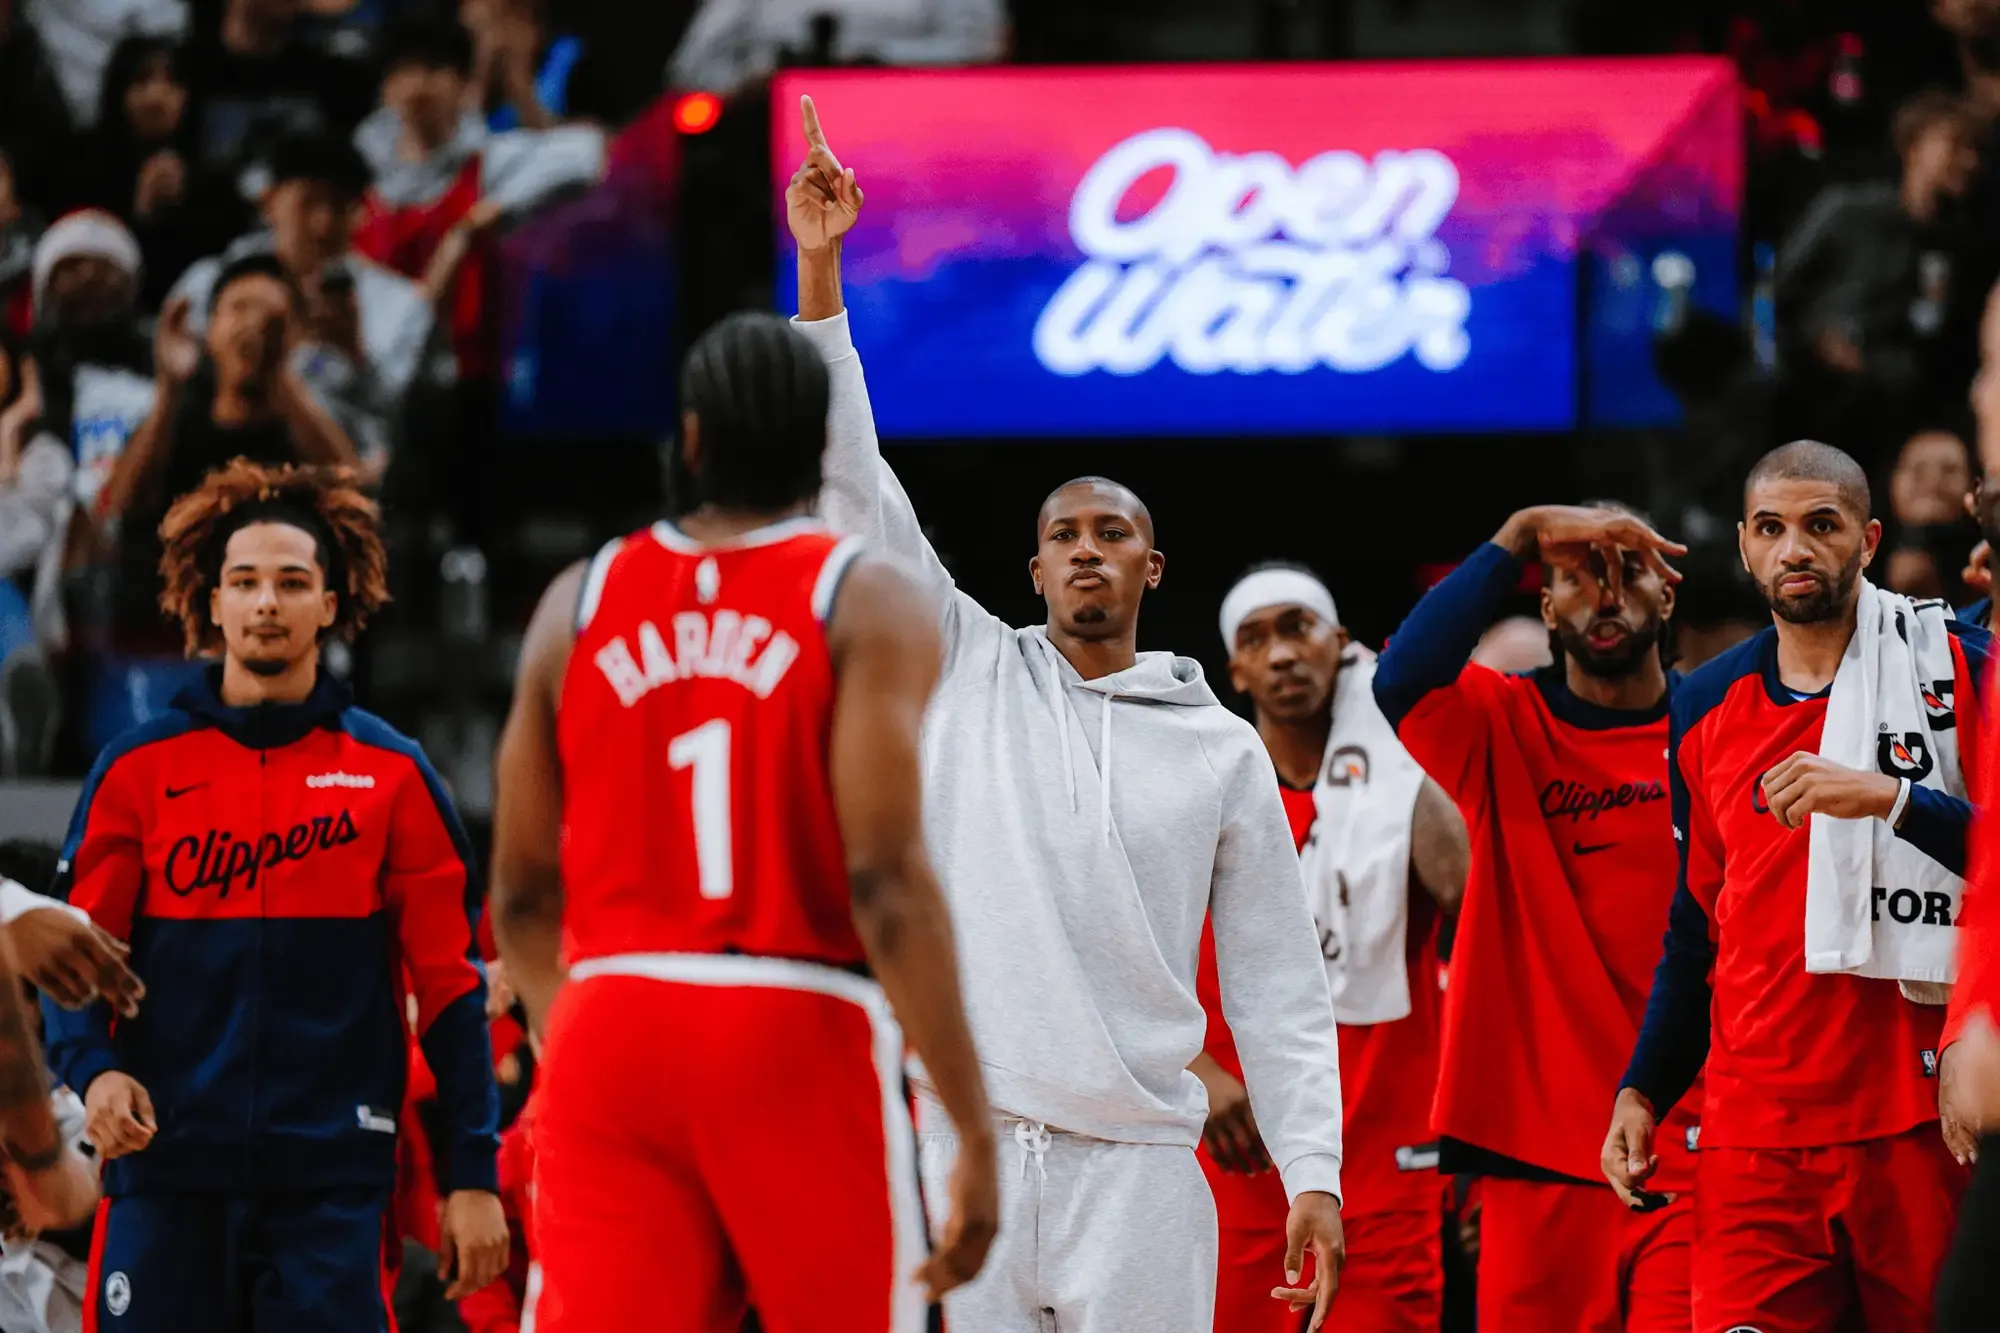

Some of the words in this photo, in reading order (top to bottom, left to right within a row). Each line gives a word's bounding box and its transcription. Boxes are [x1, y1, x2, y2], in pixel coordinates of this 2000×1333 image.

[1069, 127, 1460, 264] Open
[1032, 242, 1472, 376] Water
[593, 608, 800, 707] HARDEN
[667, 717, 733, 899] 1
[1539, 779, 1666, 822] Clippers
[165, 809, 359, 898] Clippers
[1871, 886, 1964, 927] TOR
